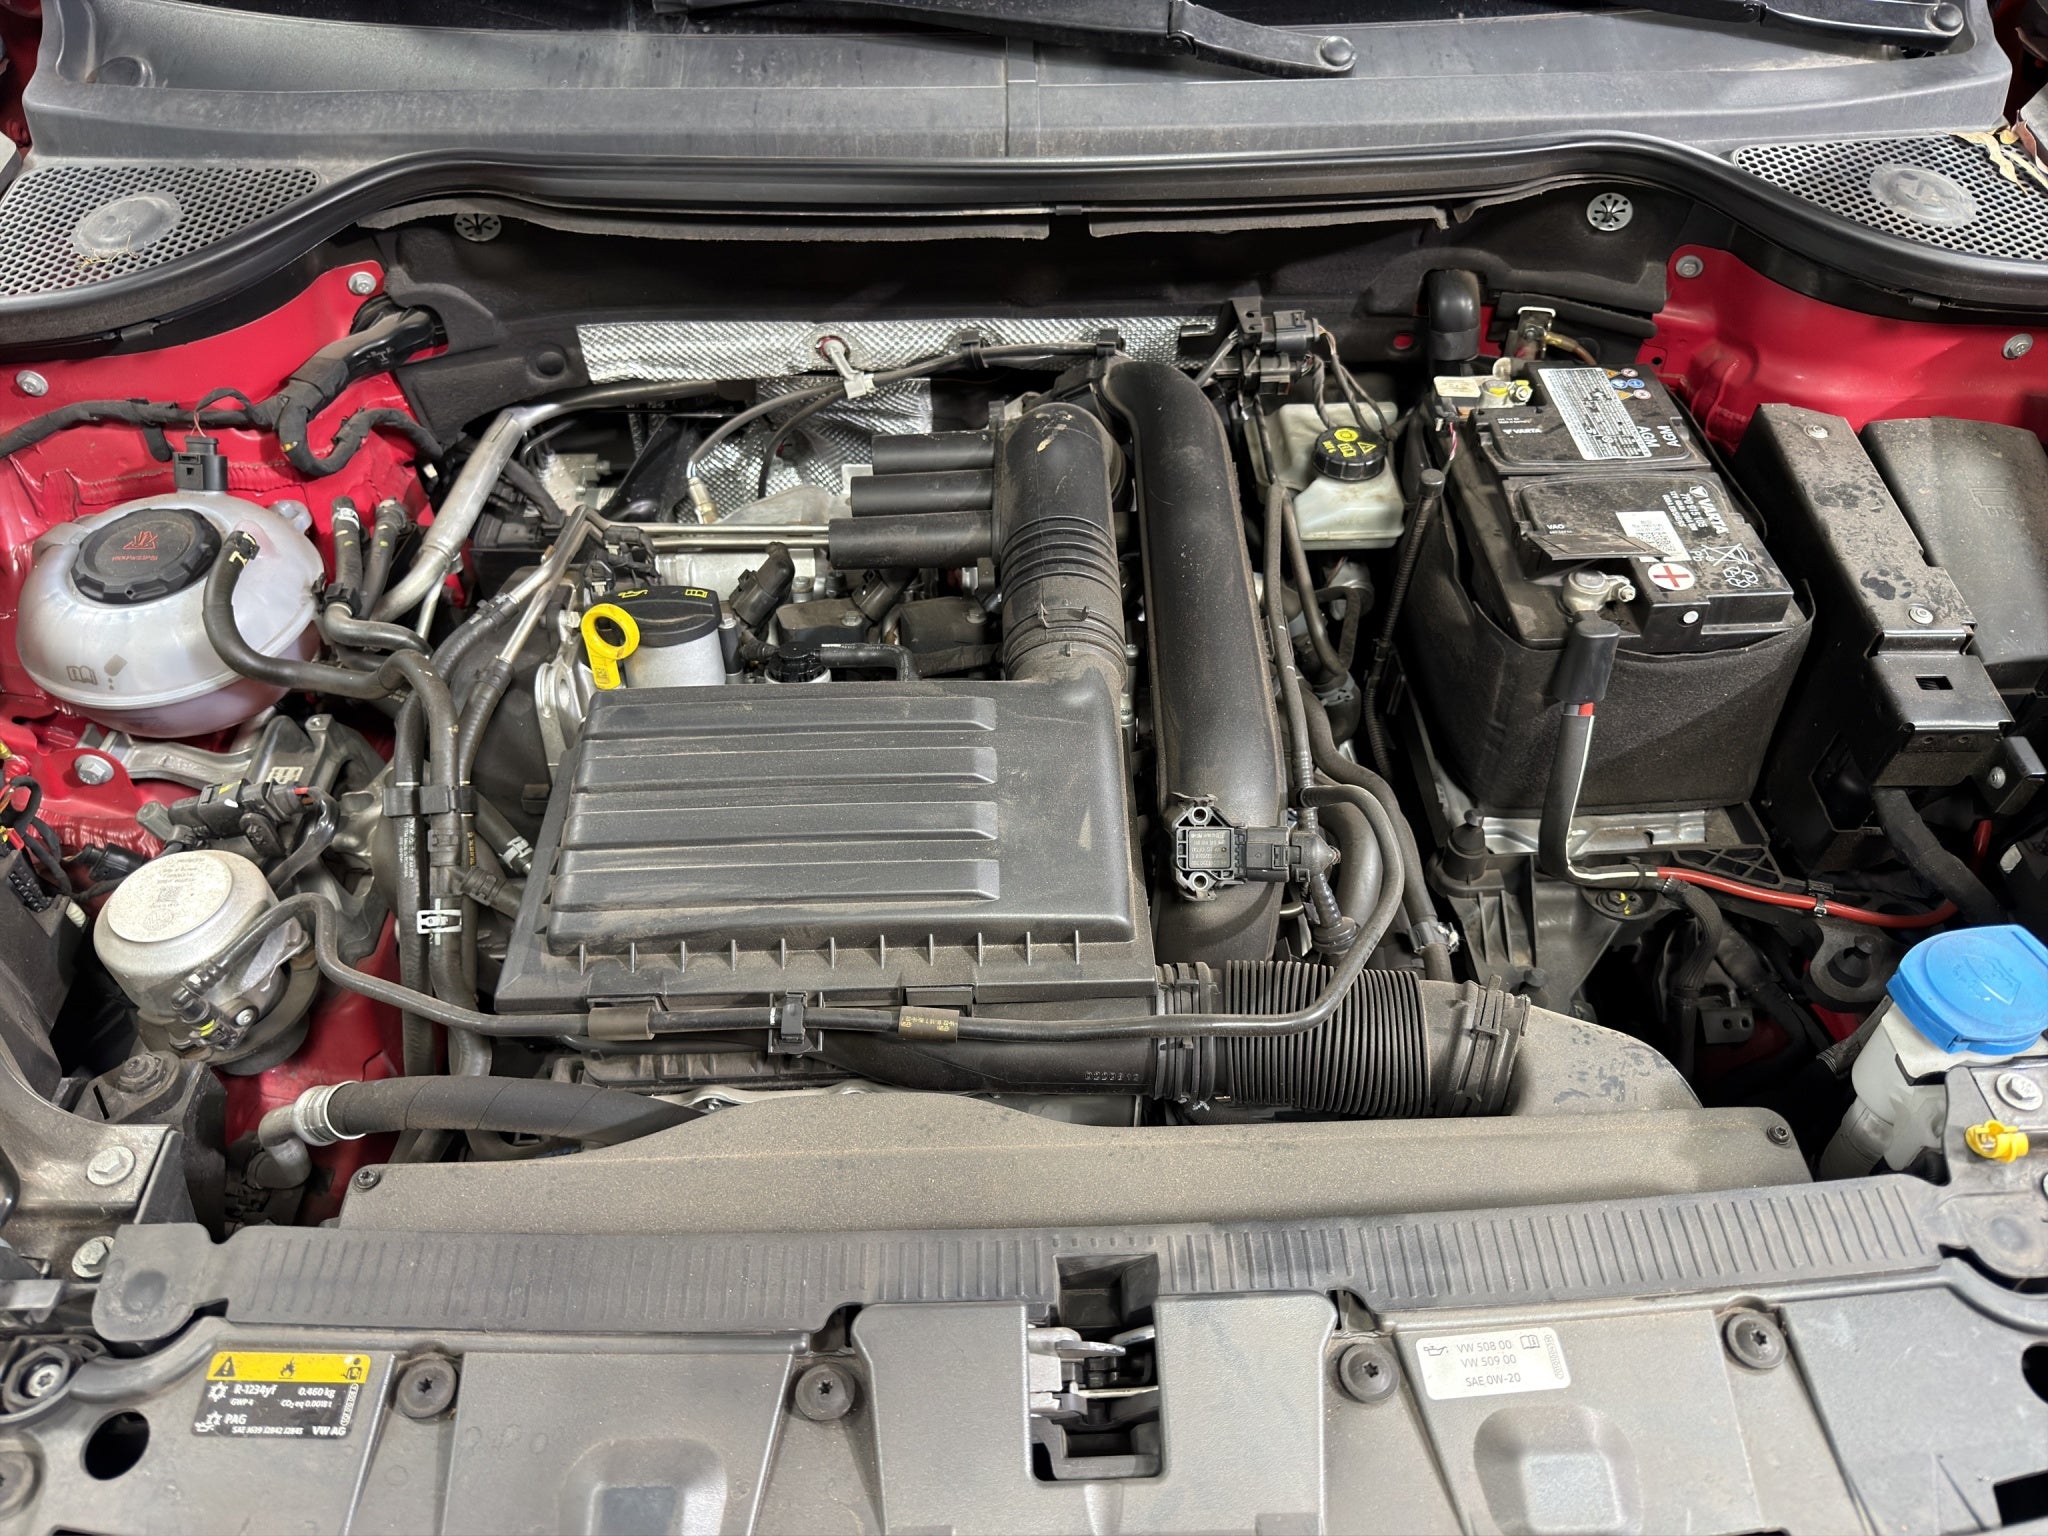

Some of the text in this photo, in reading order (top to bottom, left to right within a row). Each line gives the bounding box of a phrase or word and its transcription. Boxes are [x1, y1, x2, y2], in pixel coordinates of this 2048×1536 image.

[1637, 426, 1660, 448] AGM
[1657, 425, 1681, 448] AGM
[1698, 498, 1729, 534] VARTA
[1456, 1339, 1512, 1353] VW 508 00
[1460, 1354, 1517, 1368] VW 509 00
[1465, 1372, 1521, 1387] SAE 0W-20
[233, 1384, 336, 1398] R-1234yf 0.460 kg
[230, 1398, 248, 1406] GWP
[223, 1414, 248, 1424] PAG
[232, 1426, 246, 1434] SAE
[312, 1426, 330, 1435] VW
[330, 1426, 347, 1436] AG
